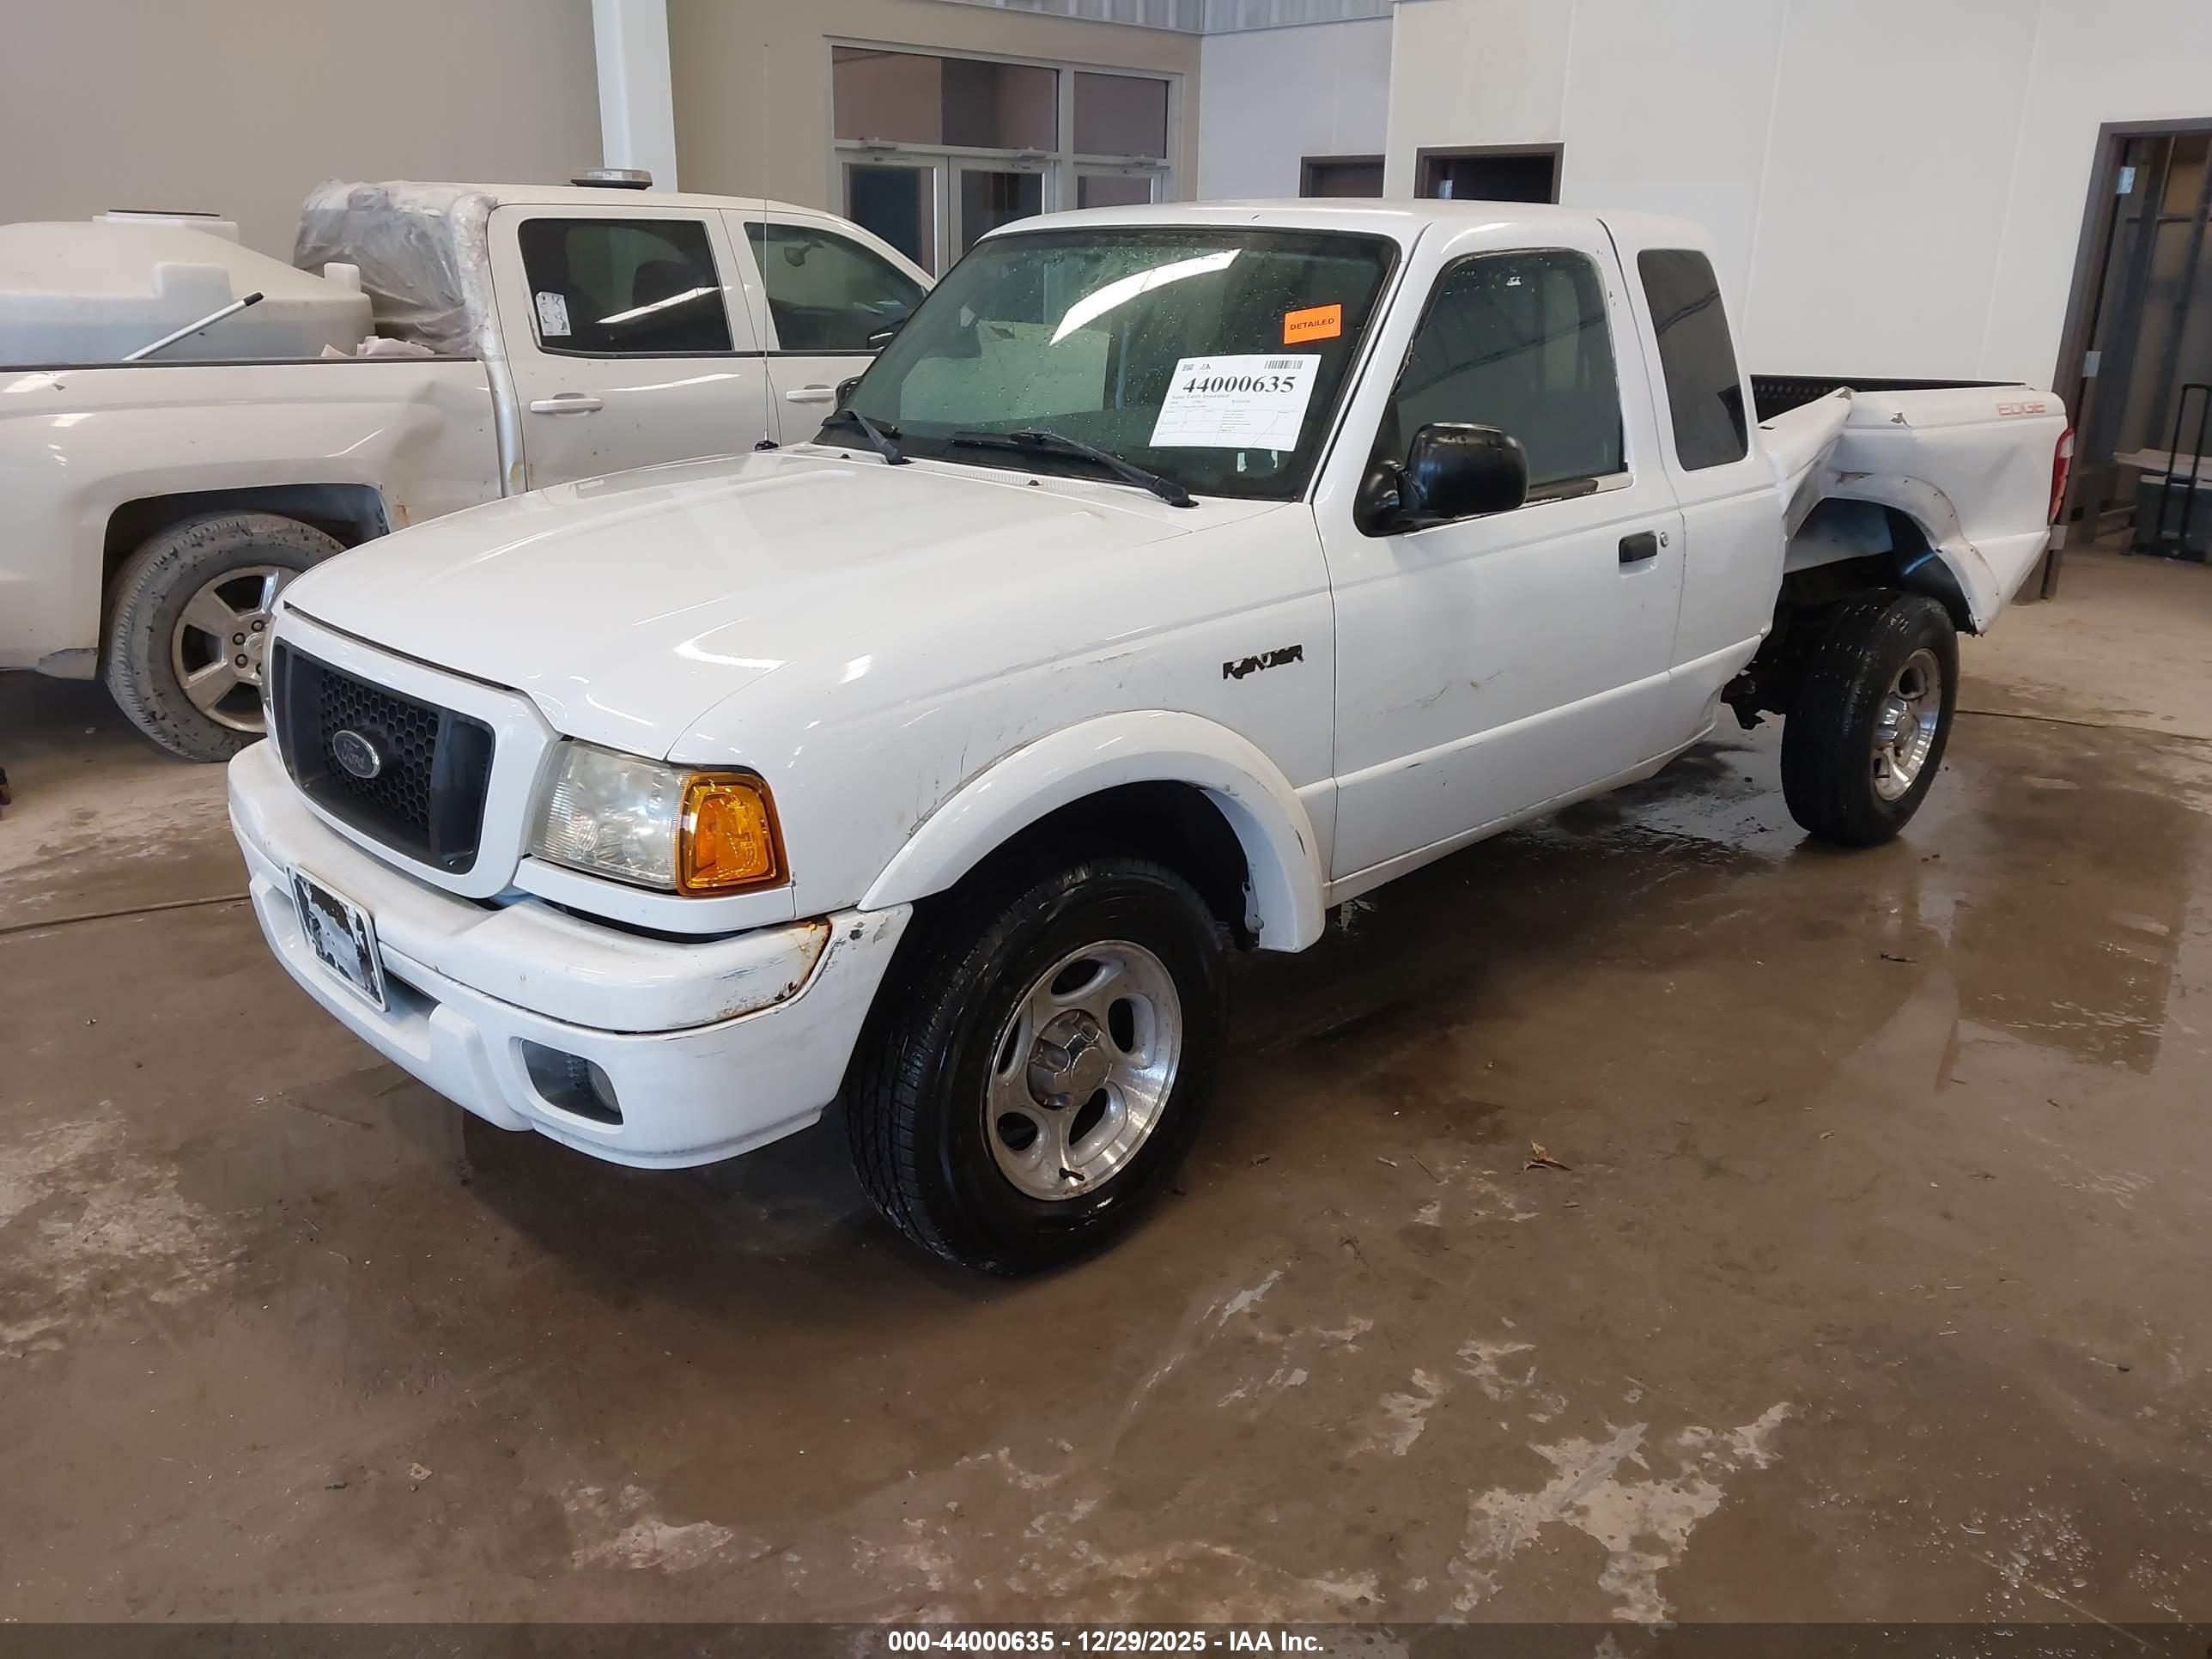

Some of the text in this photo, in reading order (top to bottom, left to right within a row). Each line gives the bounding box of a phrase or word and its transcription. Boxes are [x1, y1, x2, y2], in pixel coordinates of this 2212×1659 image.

[1290, 317, 1334, 331] DETAILED
[1182, 375, 1297, 393] 44000635
[1997, 401, 2046, 416] EDGE
[342, 738, 366, 770] Ford
